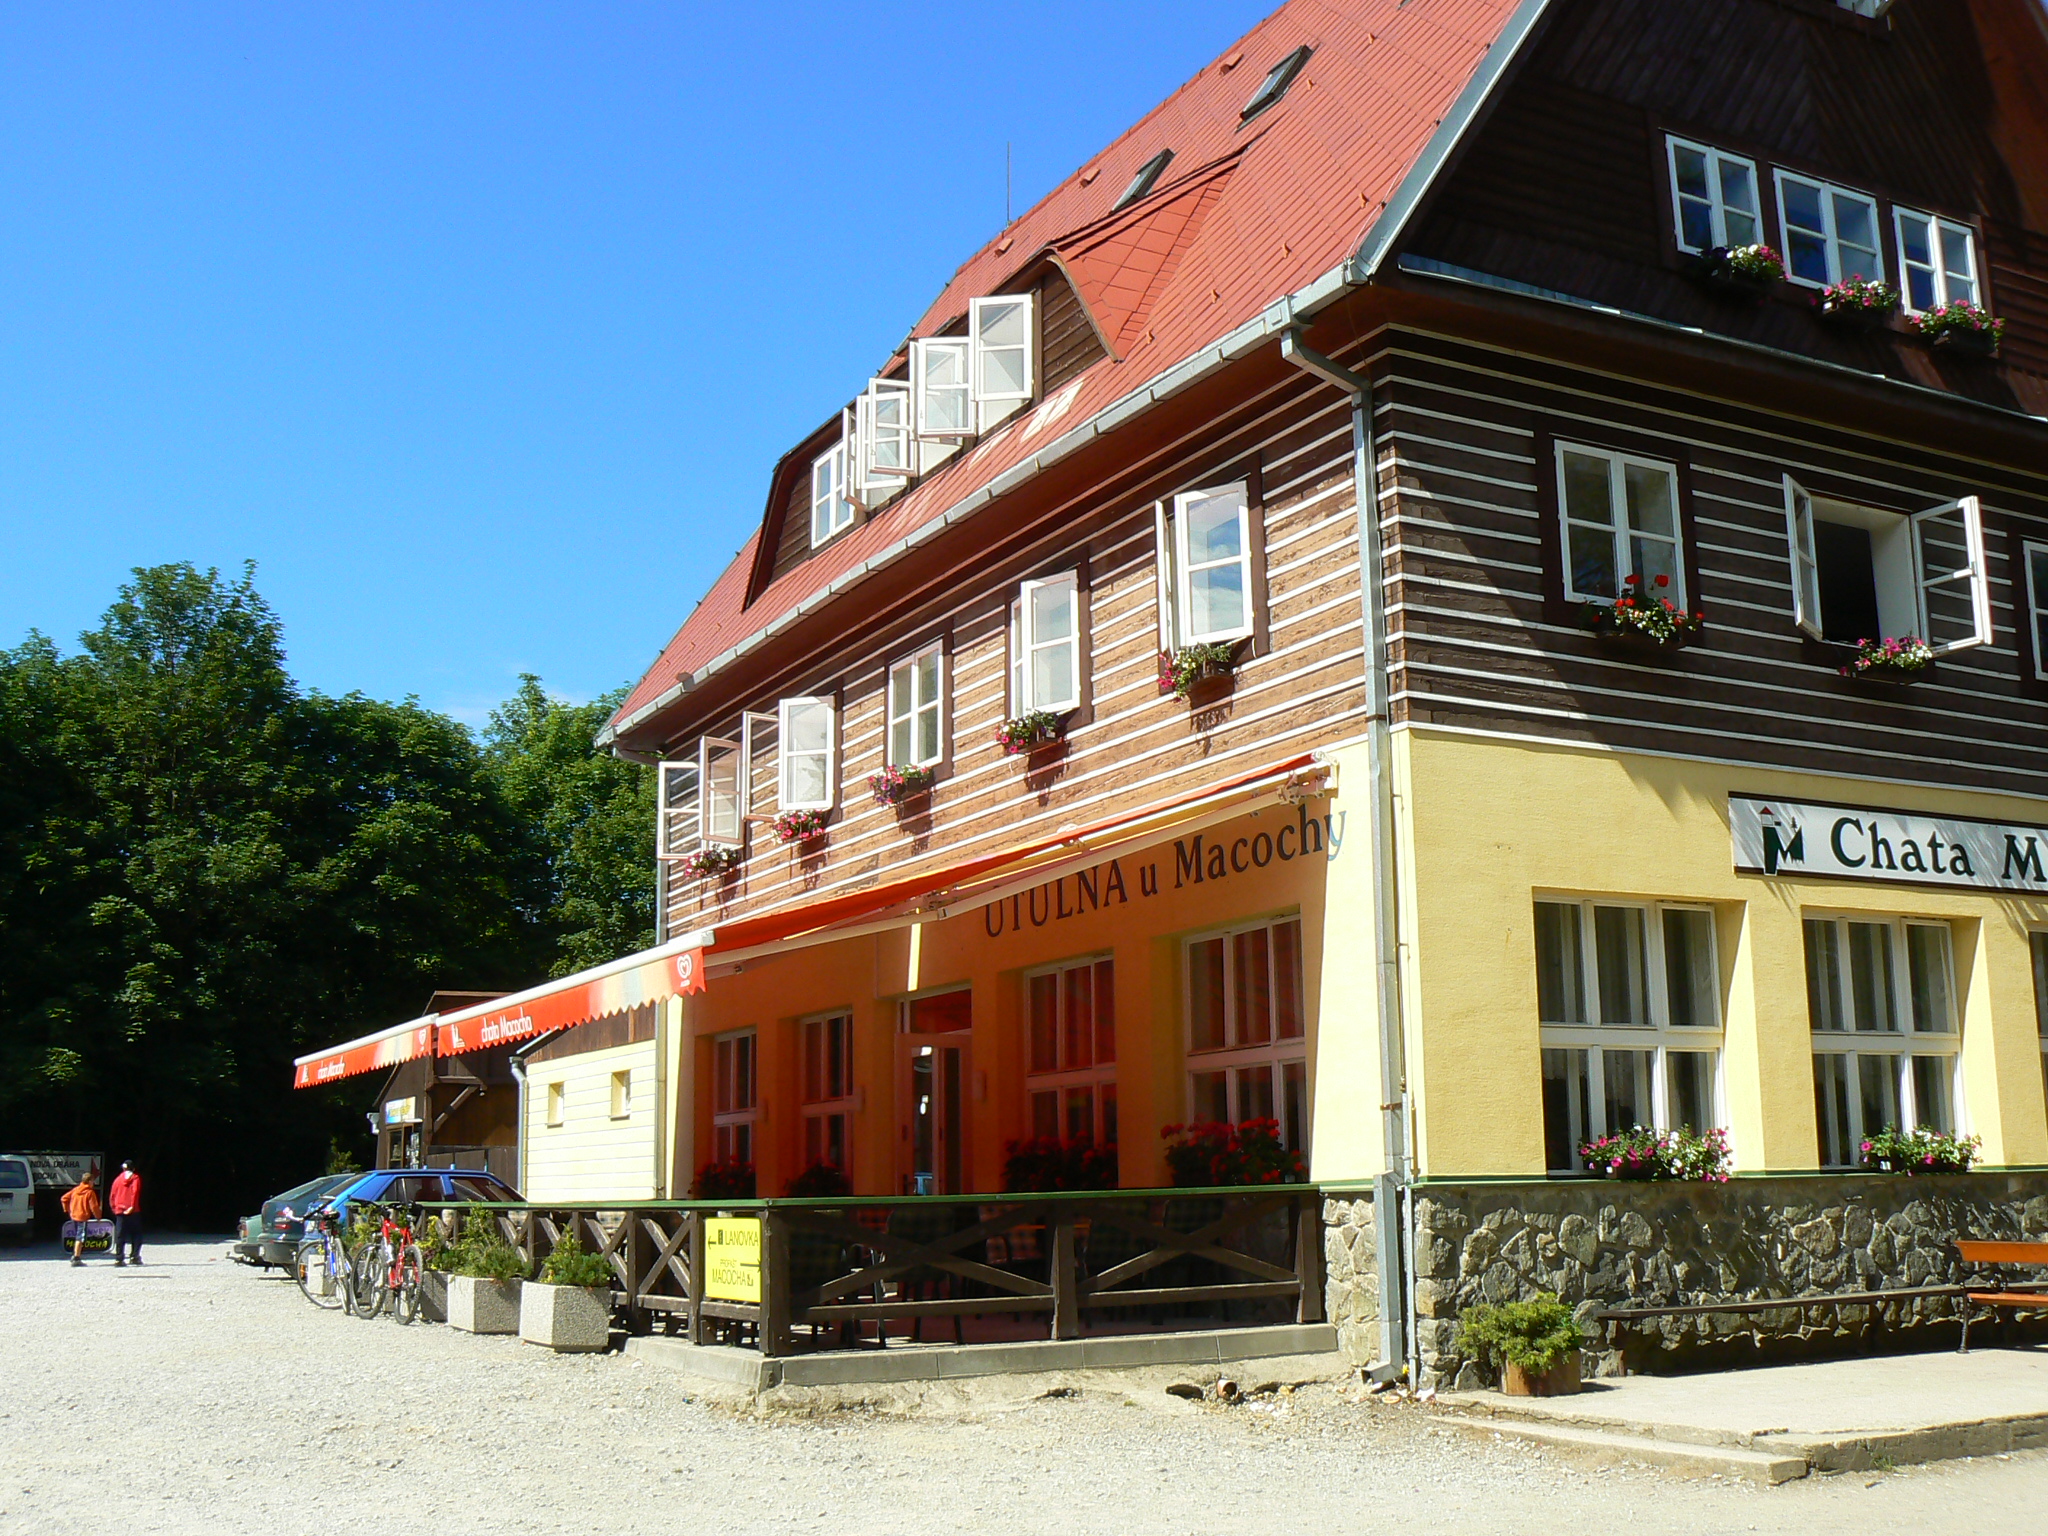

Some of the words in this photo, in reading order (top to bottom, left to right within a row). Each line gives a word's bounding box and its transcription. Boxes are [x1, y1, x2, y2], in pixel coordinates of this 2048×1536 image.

[1139, 863, 1158, 897] u
[1173, 804, 1347, 889] Macochy
[1830, 816, 1976, 877] Chata
[500, 1006, 533, 1038] Macocha
[724, 1230, 759, 1247] LANOVKA
[712, 1268, 746, 1286] MACOCHA
